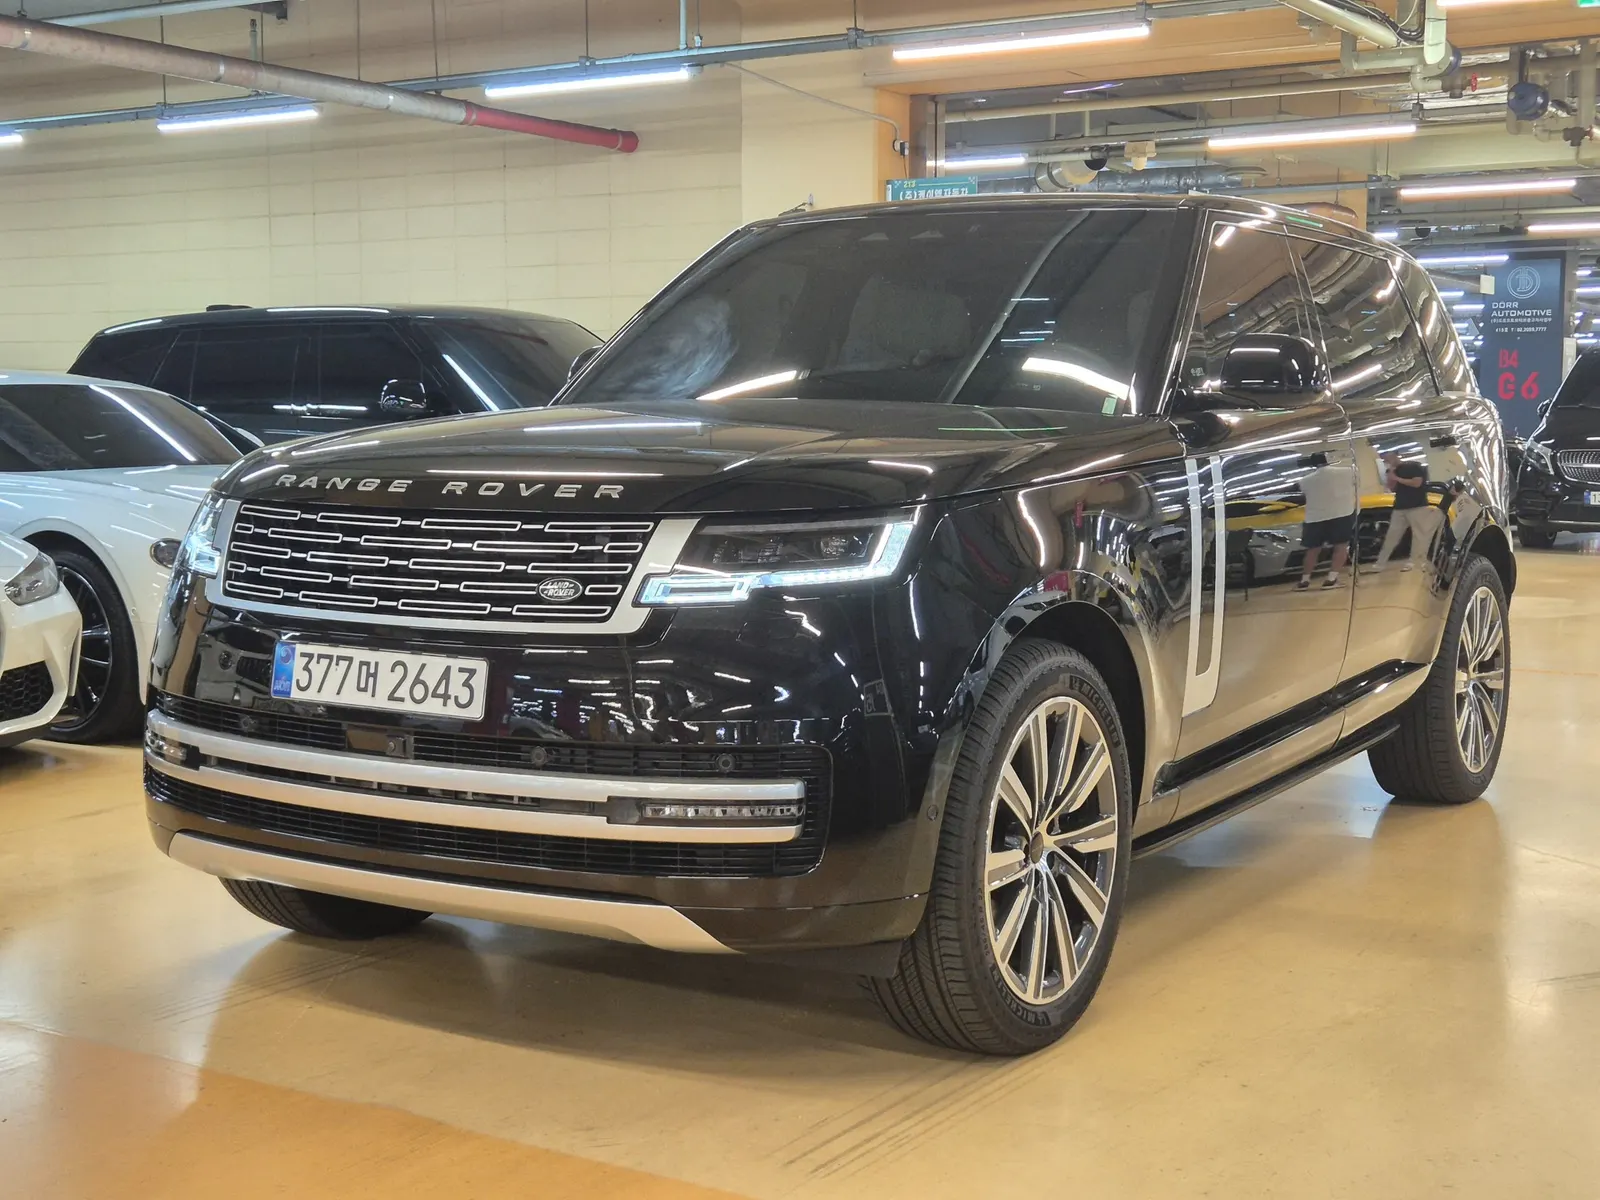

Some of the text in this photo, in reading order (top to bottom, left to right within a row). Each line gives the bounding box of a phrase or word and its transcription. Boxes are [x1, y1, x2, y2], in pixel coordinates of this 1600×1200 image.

[1491, 309, 1552, 317] AUTOMOTIVE
[275, 474, 625, 499] RANGE ROVER
[547, 581, 570, 589] LAND
[547, 588, 575, 597] ROVER
[295, 652, 478, 710] 377머 2643
[1080, 682, 1120, 743] MICHELIN
